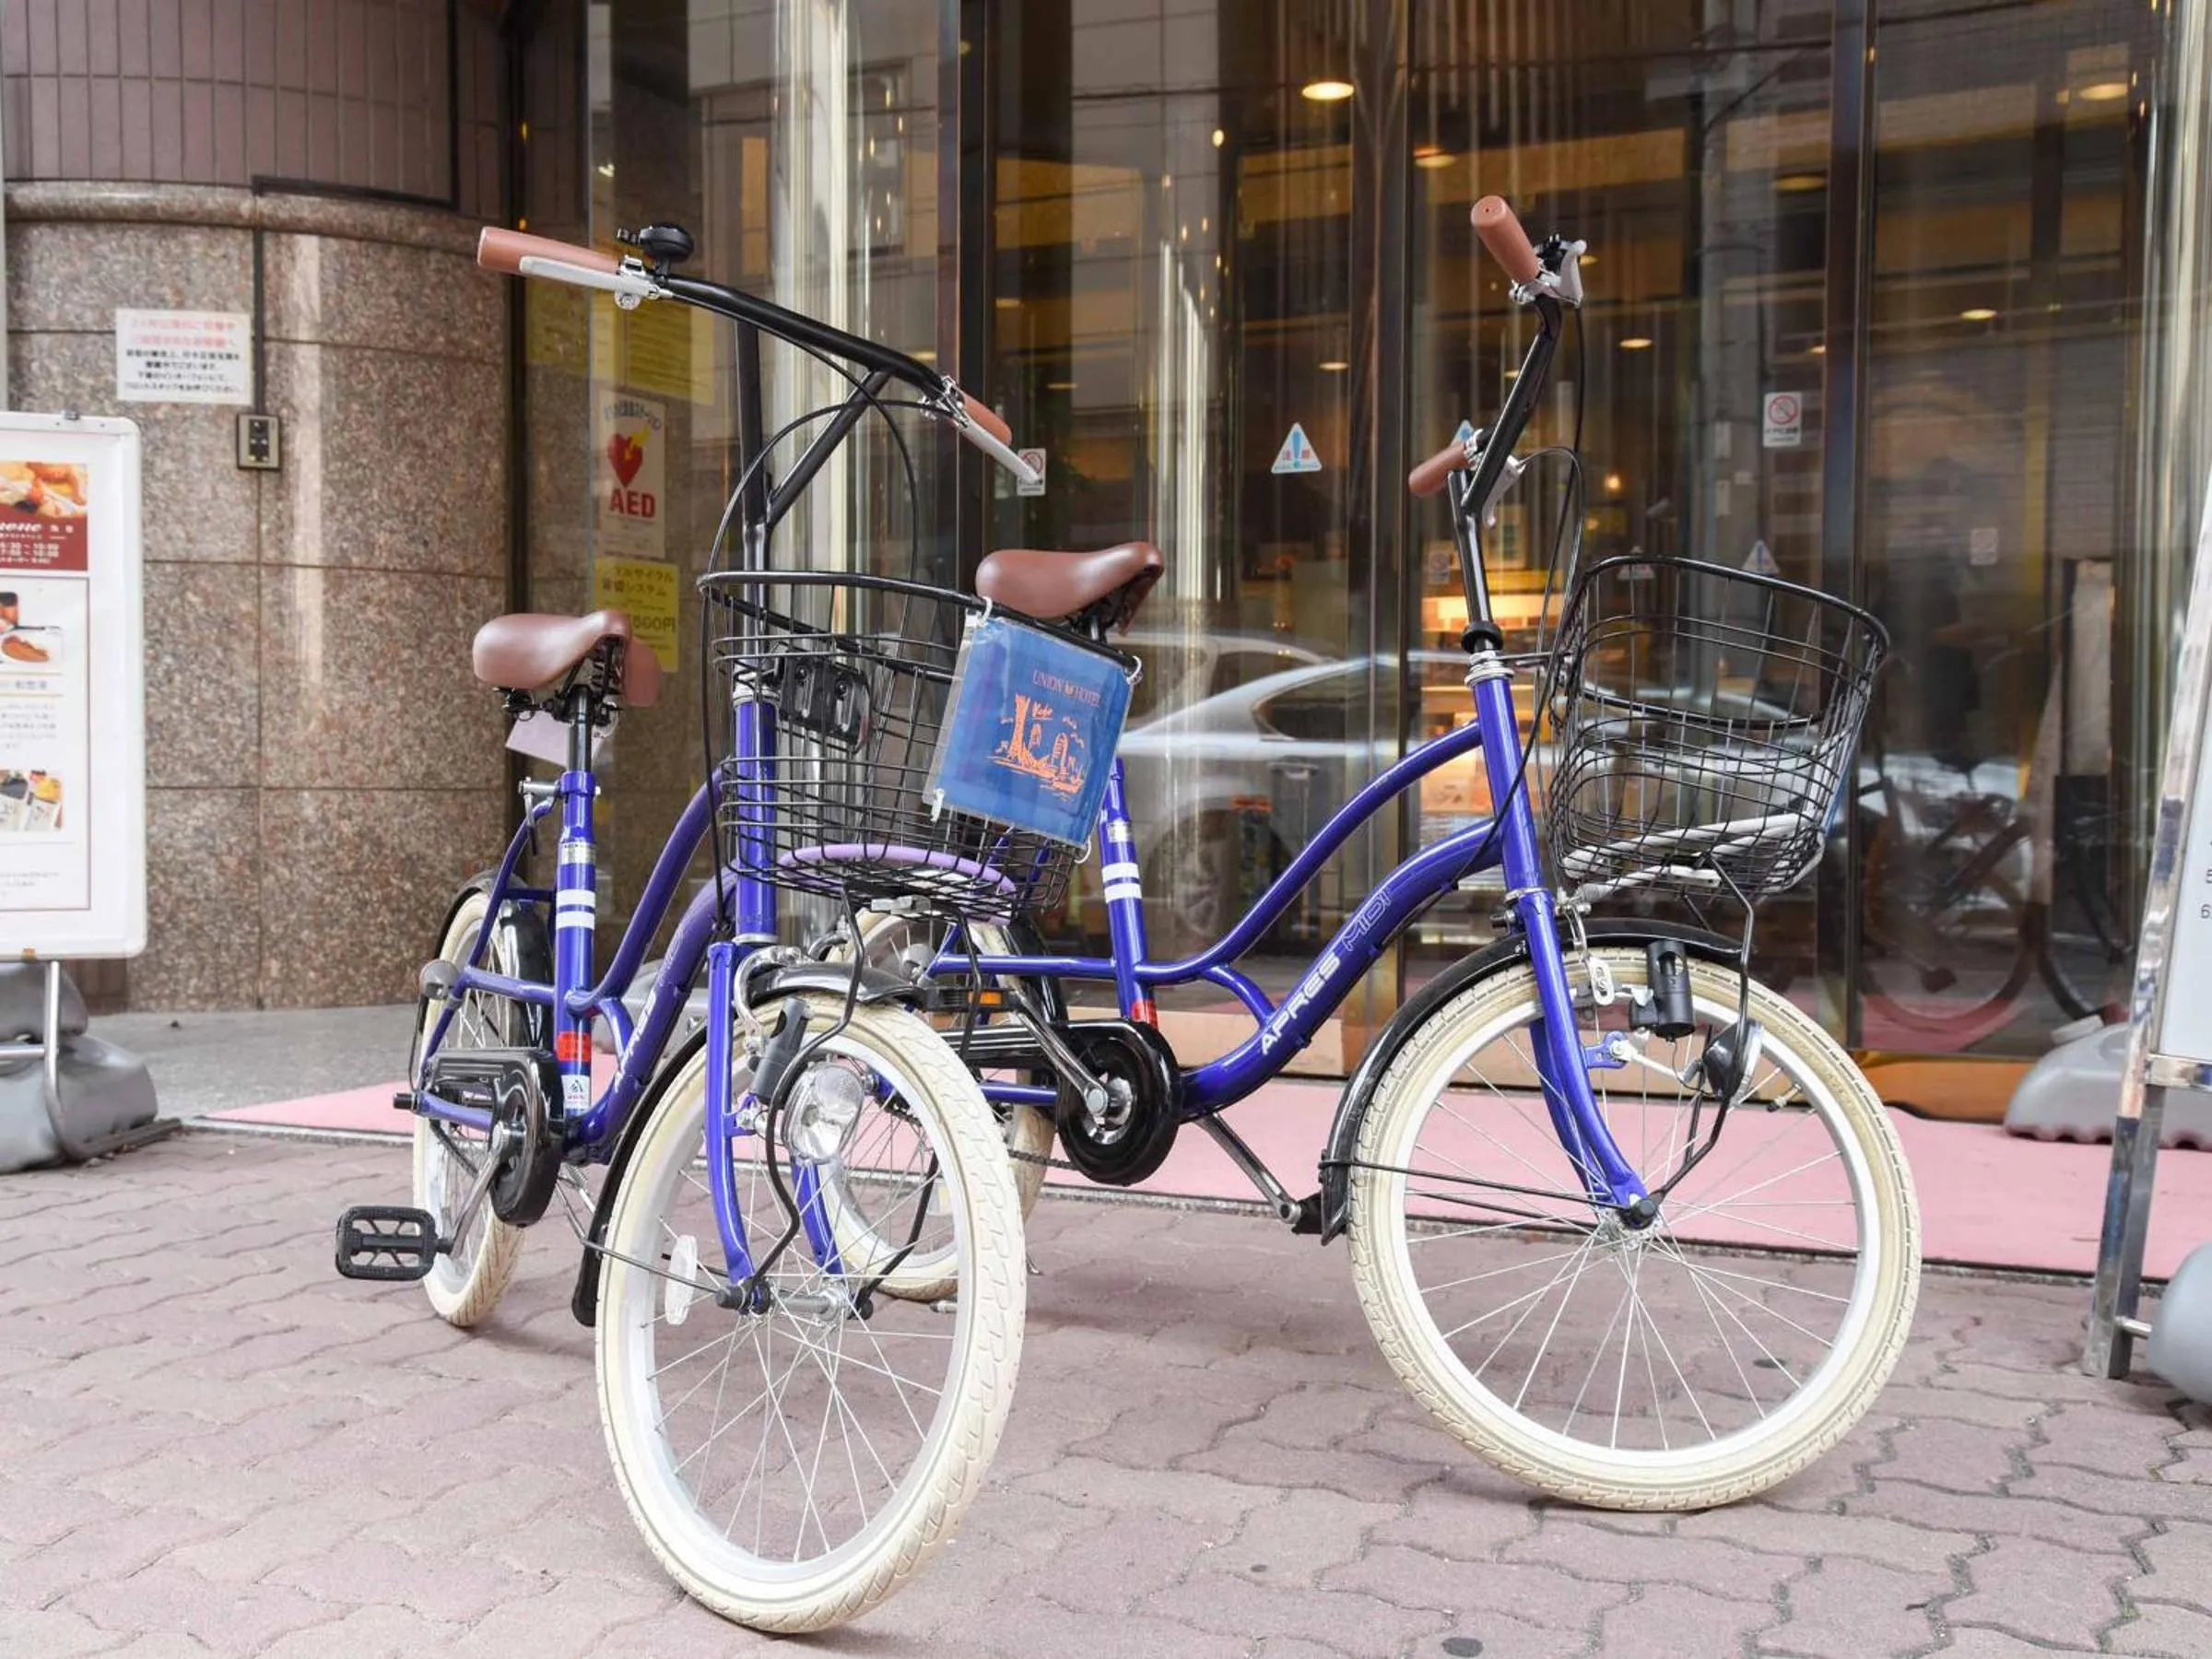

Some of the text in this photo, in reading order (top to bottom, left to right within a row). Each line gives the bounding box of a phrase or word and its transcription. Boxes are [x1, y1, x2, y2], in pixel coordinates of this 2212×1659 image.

[609, 488, 656, 519] AED
[1032, 669, 1101, 708] UNION HOTEL
[1262, 889, 1392, 1056] APRES MIDI
